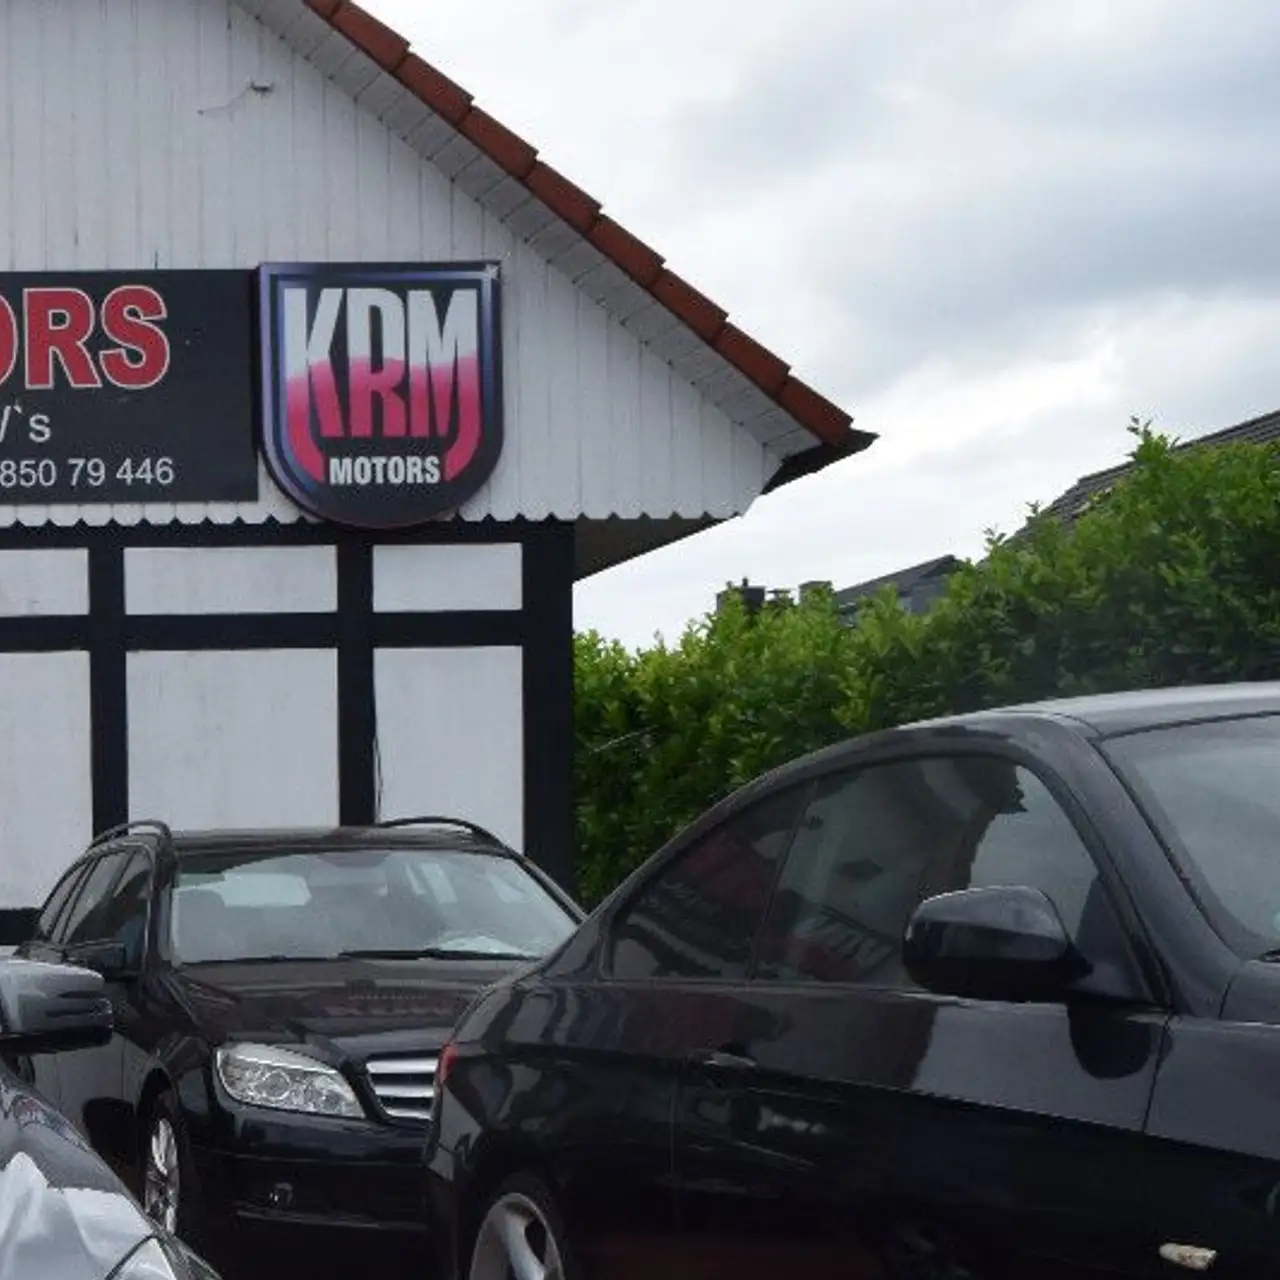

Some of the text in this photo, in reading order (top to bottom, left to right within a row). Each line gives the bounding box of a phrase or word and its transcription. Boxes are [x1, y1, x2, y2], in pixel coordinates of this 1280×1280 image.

[284, 288, 481, 480] KRM
[68, 458, 106, 486] 79
[116, 457, 174, 486] 446
[329, 455, 441, 486] MOTORS
